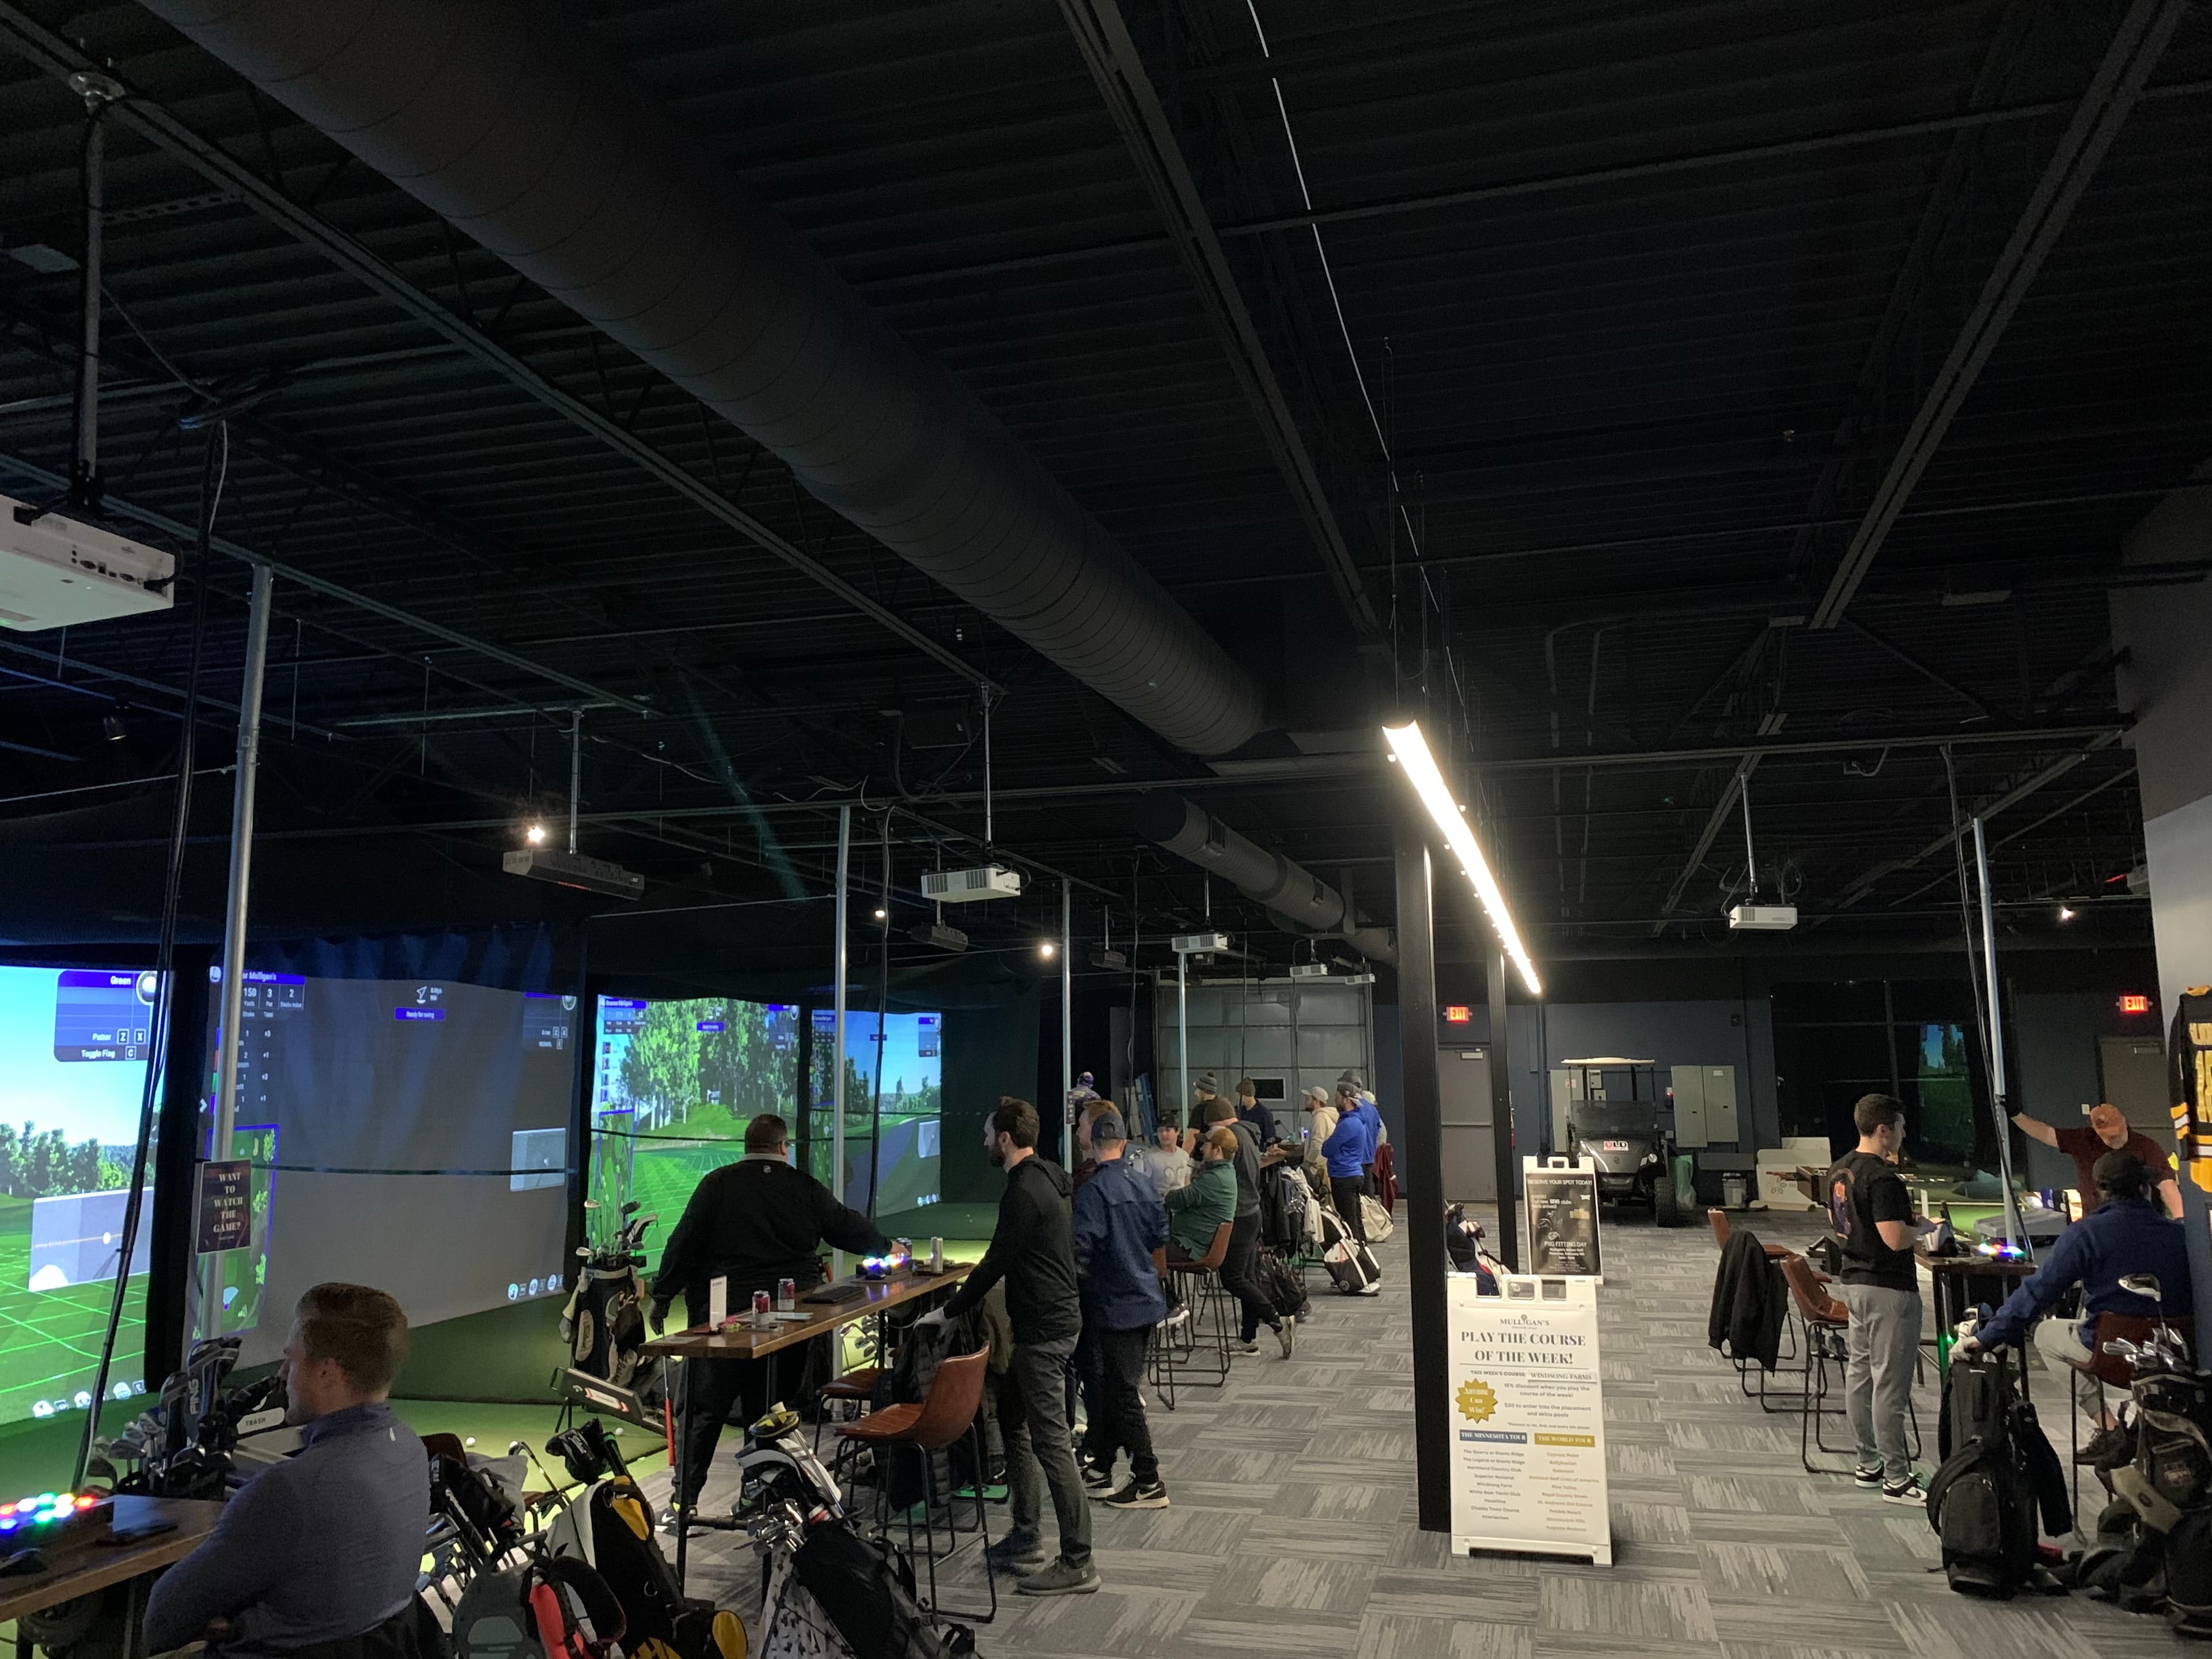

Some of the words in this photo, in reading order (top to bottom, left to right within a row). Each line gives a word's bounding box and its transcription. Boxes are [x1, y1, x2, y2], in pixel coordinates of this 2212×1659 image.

[111, 976, 131, 985] Green
[249, 972, 276, 982] Mulligan's
[243, 988, 257, 997] 150
[267, 988, 272, 998] 3
[289, 989, 294, 998] 2
[2125, 997, 2145, 1010] EXIT
[1450, 1007, 1467, 1020] EXIT
[81, 1050, 102, 1059] Toggle
[103, 1050, 116, 1058] Flag
[219, 1173, 241, 1183] WANT
[225, 1185, 236, 1194] TO
[214, 1196, 243, 1207] WATCH
[221, 1210, 236, 1219] THE
[213, 1221, 241, 1233] GAME?
[1500, 1317, 1550, 1327] MULLIGAN'S
[1461, 1331, 1495, 1342] PLAY
[1498, 1333, 1527, 1344] THE
[1530, 1334, 1586, 1346] COURSE
[1475, 1350, 1494, 1361] OF
[1497, 1351, 1525, 1362] THE
[1528, 1353, 1573, 1364] WEEK!
[189, 1378, 200, 1415] PING
[245, 1417, 266, 1426] TRASH
[1475, 1432, 1509, 1440] MINNESOTA
